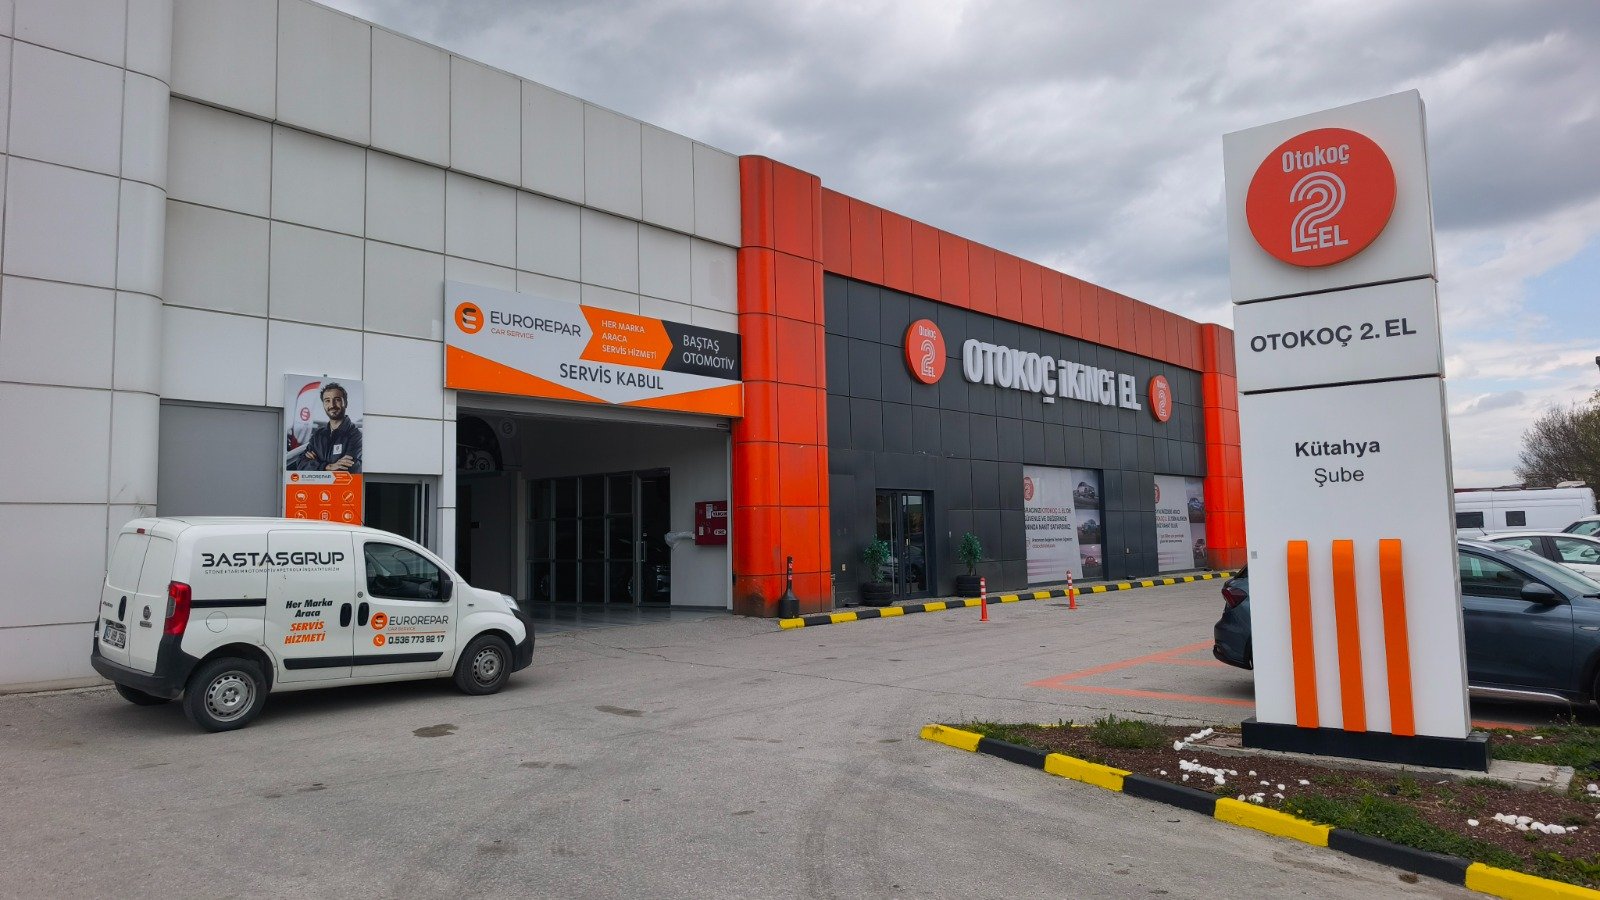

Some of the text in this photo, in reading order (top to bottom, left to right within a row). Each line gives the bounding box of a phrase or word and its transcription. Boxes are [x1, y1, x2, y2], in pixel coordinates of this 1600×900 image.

[1281, 143, 1350, 173] Otokoç
[490, 310, 581, 337] EUROREPAR
[601, 319, 645, 333] HER MARKA
[491, 327, 534, 339] CAR SERVICE
[601, 332, 628, 343] ARACA
[1250, 317, 1417, 353] OTOKOÇ 2. EL
[602, 344, 657, 360] SERVİS HİZMETİ
[683, 334, 720, 354] BAŞTAŞ
[682, 351, 735, 371] OTOMOTİV
[559, 362, 664, 390] SERVİS KABUL
[962, 338, 1142, 411] OTOKOÇ İKİNCİ EL
[1295, 439, 1381, 458] Kütahya
[1314, 466, 1364, 488] Şube
[285, 598, 333, 609] Her Marka
[294, 609, 321, 618] Araca
[389, 615, 449, 626] EUROREPAR
[290, 619, 325, 631] SERVİS
[284, 630, 327, 644] HİZMETİ
[410, 634, 425, 644] 773
[425, 634, 436, 643] 92
[436, 634, 445, 643] 17
